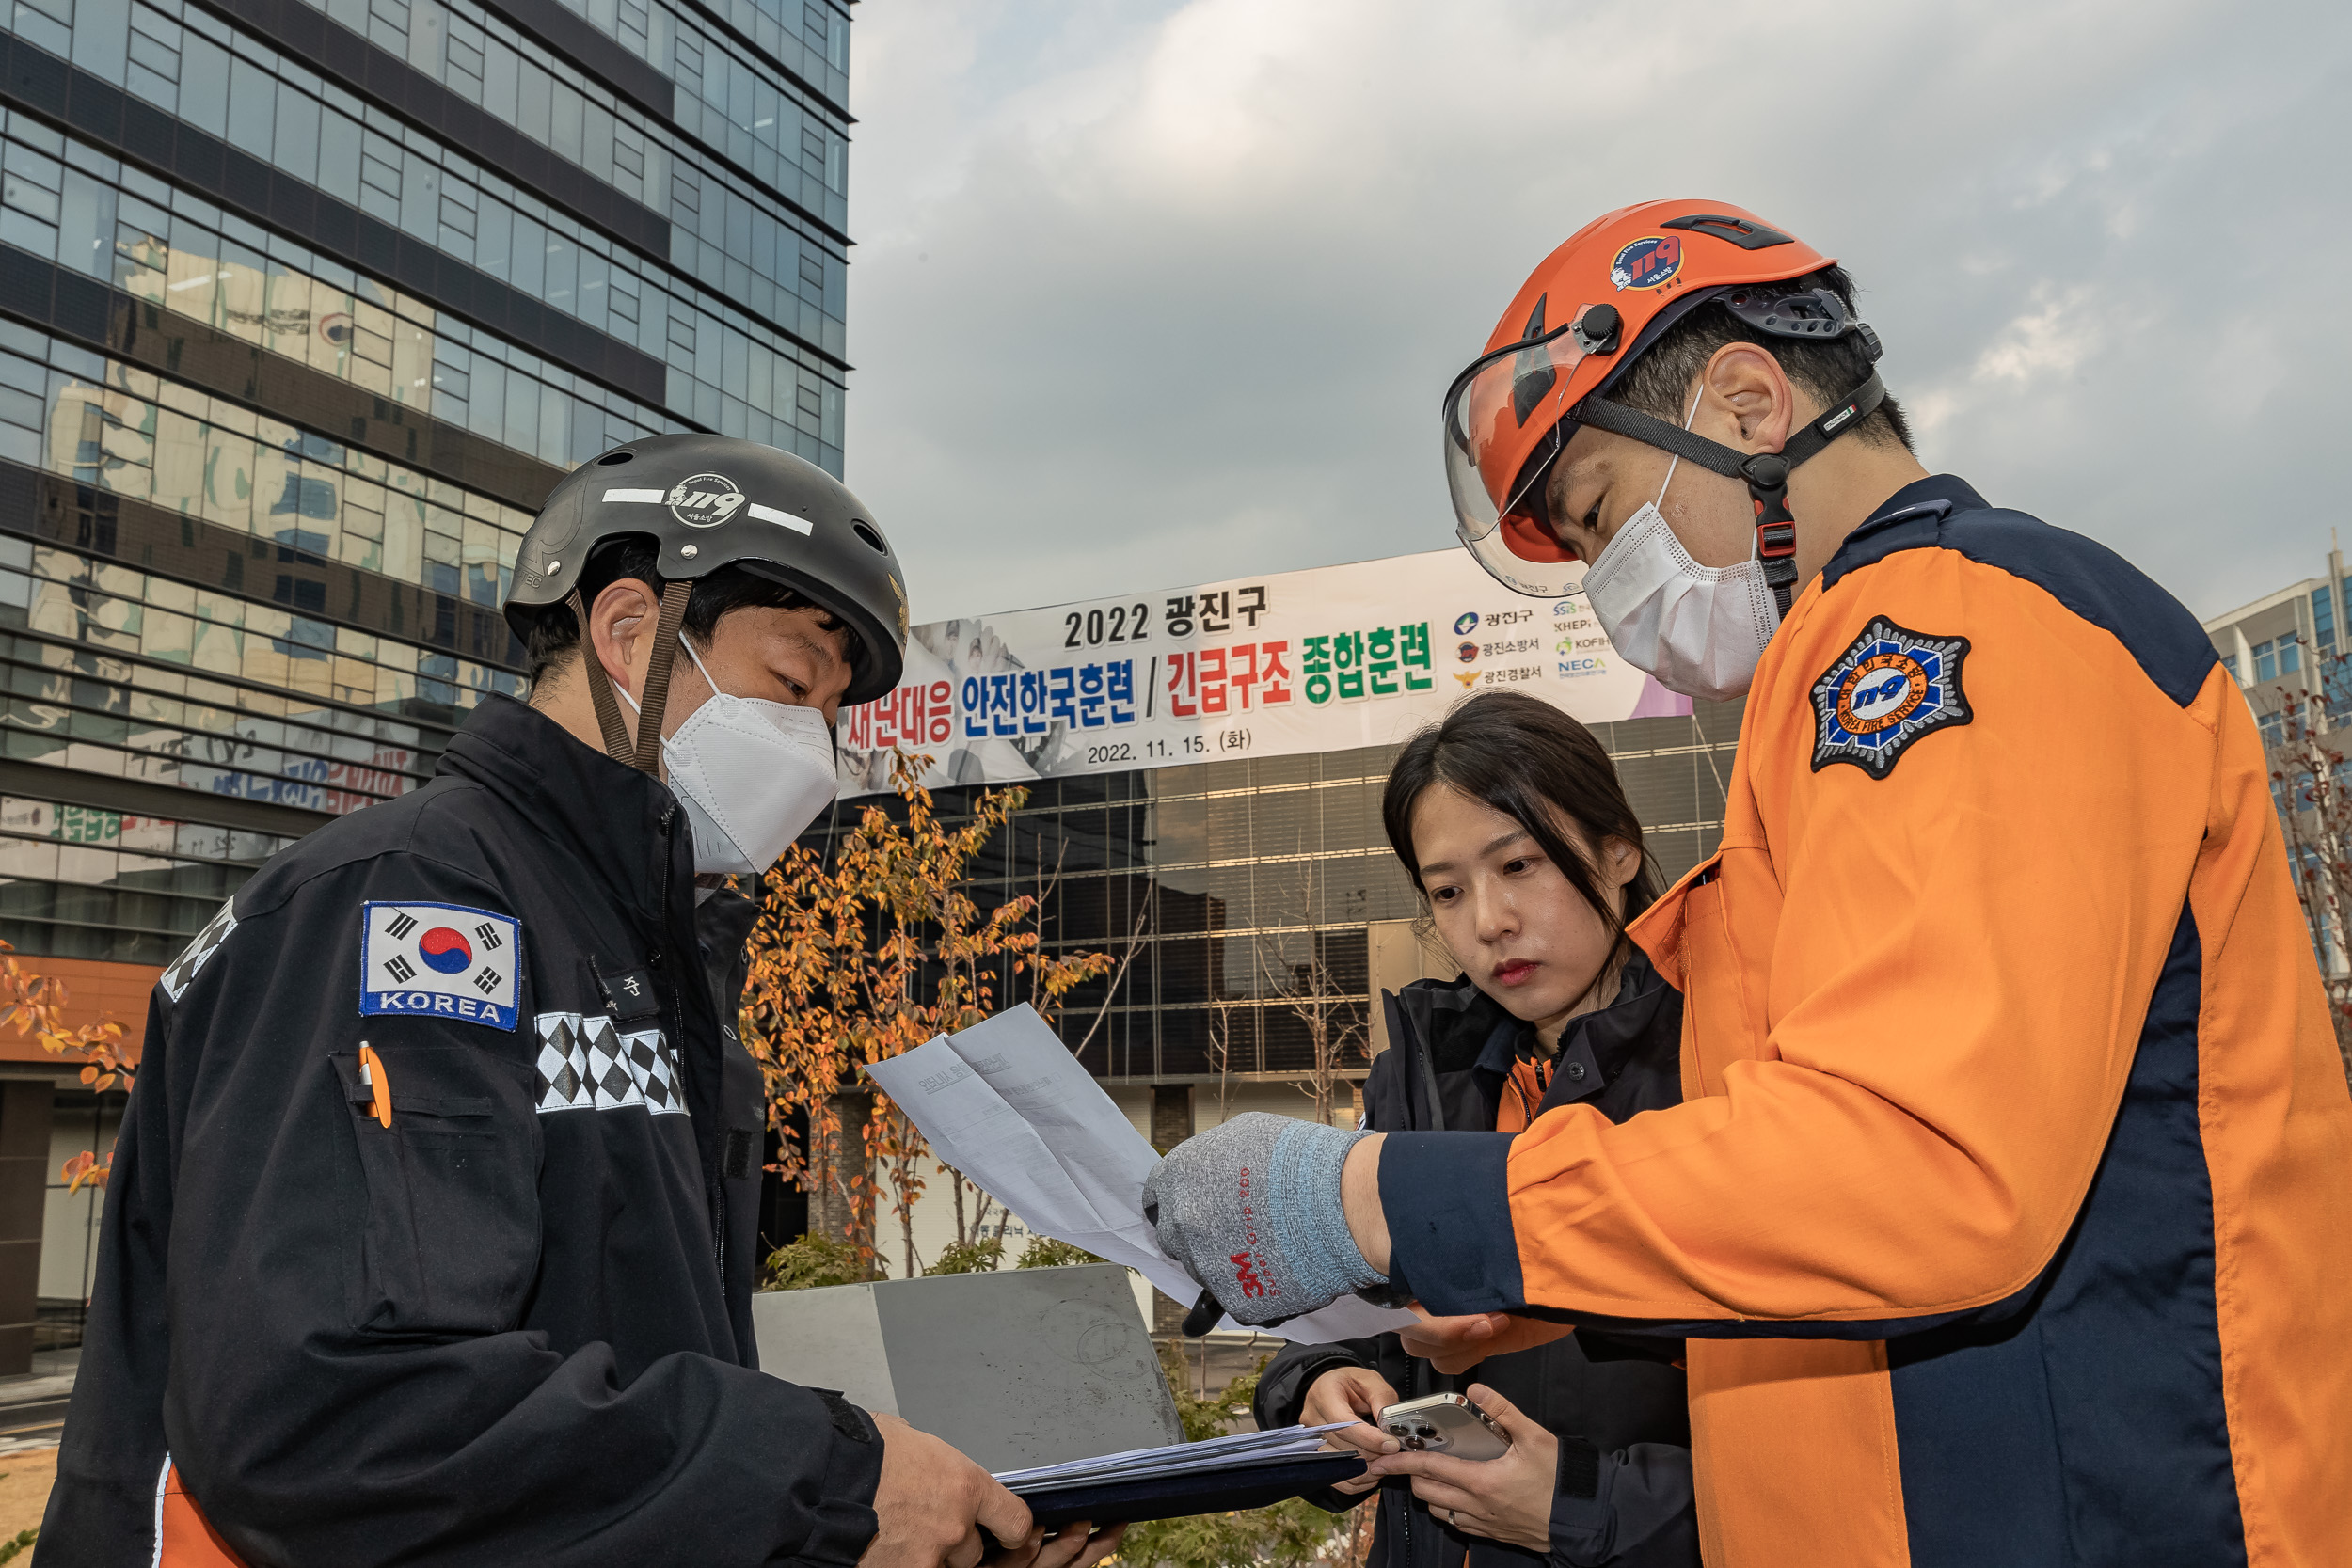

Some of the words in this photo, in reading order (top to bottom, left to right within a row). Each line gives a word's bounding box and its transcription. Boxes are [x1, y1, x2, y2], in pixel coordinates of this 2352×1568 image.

[1630, 236, 1679, 281] 119
[680, 491, 746, 516] 119
[687, 513, 713, 522] 서울소방
[1754, 583, 1762, 605] Korea
[1064, 603, 1150, 649] 2022
[1165, 585, 1267, 637] 광진구
[1485, 610, 1534, 627] 광진구
[1758, 615, 1768, 635] Made
[1483, 638, 1540, 657] 광진소방서
[961, 659, 1135, 738] 안전한국훈련
[1168, 641, 1292, 718] 긴급구조
[1303, 621, 1432, 705] 종합훈련
[1485, 665, 1542, 685] 광진경찰서
[1558, 657, 1606, 672] NECA
[1851, 674, 1908, 711] 119
[1838, 709, 1860, 732] KOREA
[1862, 717, 1883, 732] FIRE
[1888, 689, 1924, 724] SERVICE
[1088, 744, 1136, 765] 2022.
[1147, 739, 1173, 757] 11.
[1183, 735, 1210, 754] 15.
[1219, 728, 1251, 752] (화)
[380, 992, 501, 1023] KOREA
[1239, 1167, 1250, 1198] 200
[1244, 1206, 1257, 1245] Grip
[1230, 1251, 1264, 1299] 3M
[1256, 1251, 1281, 1298] Super
